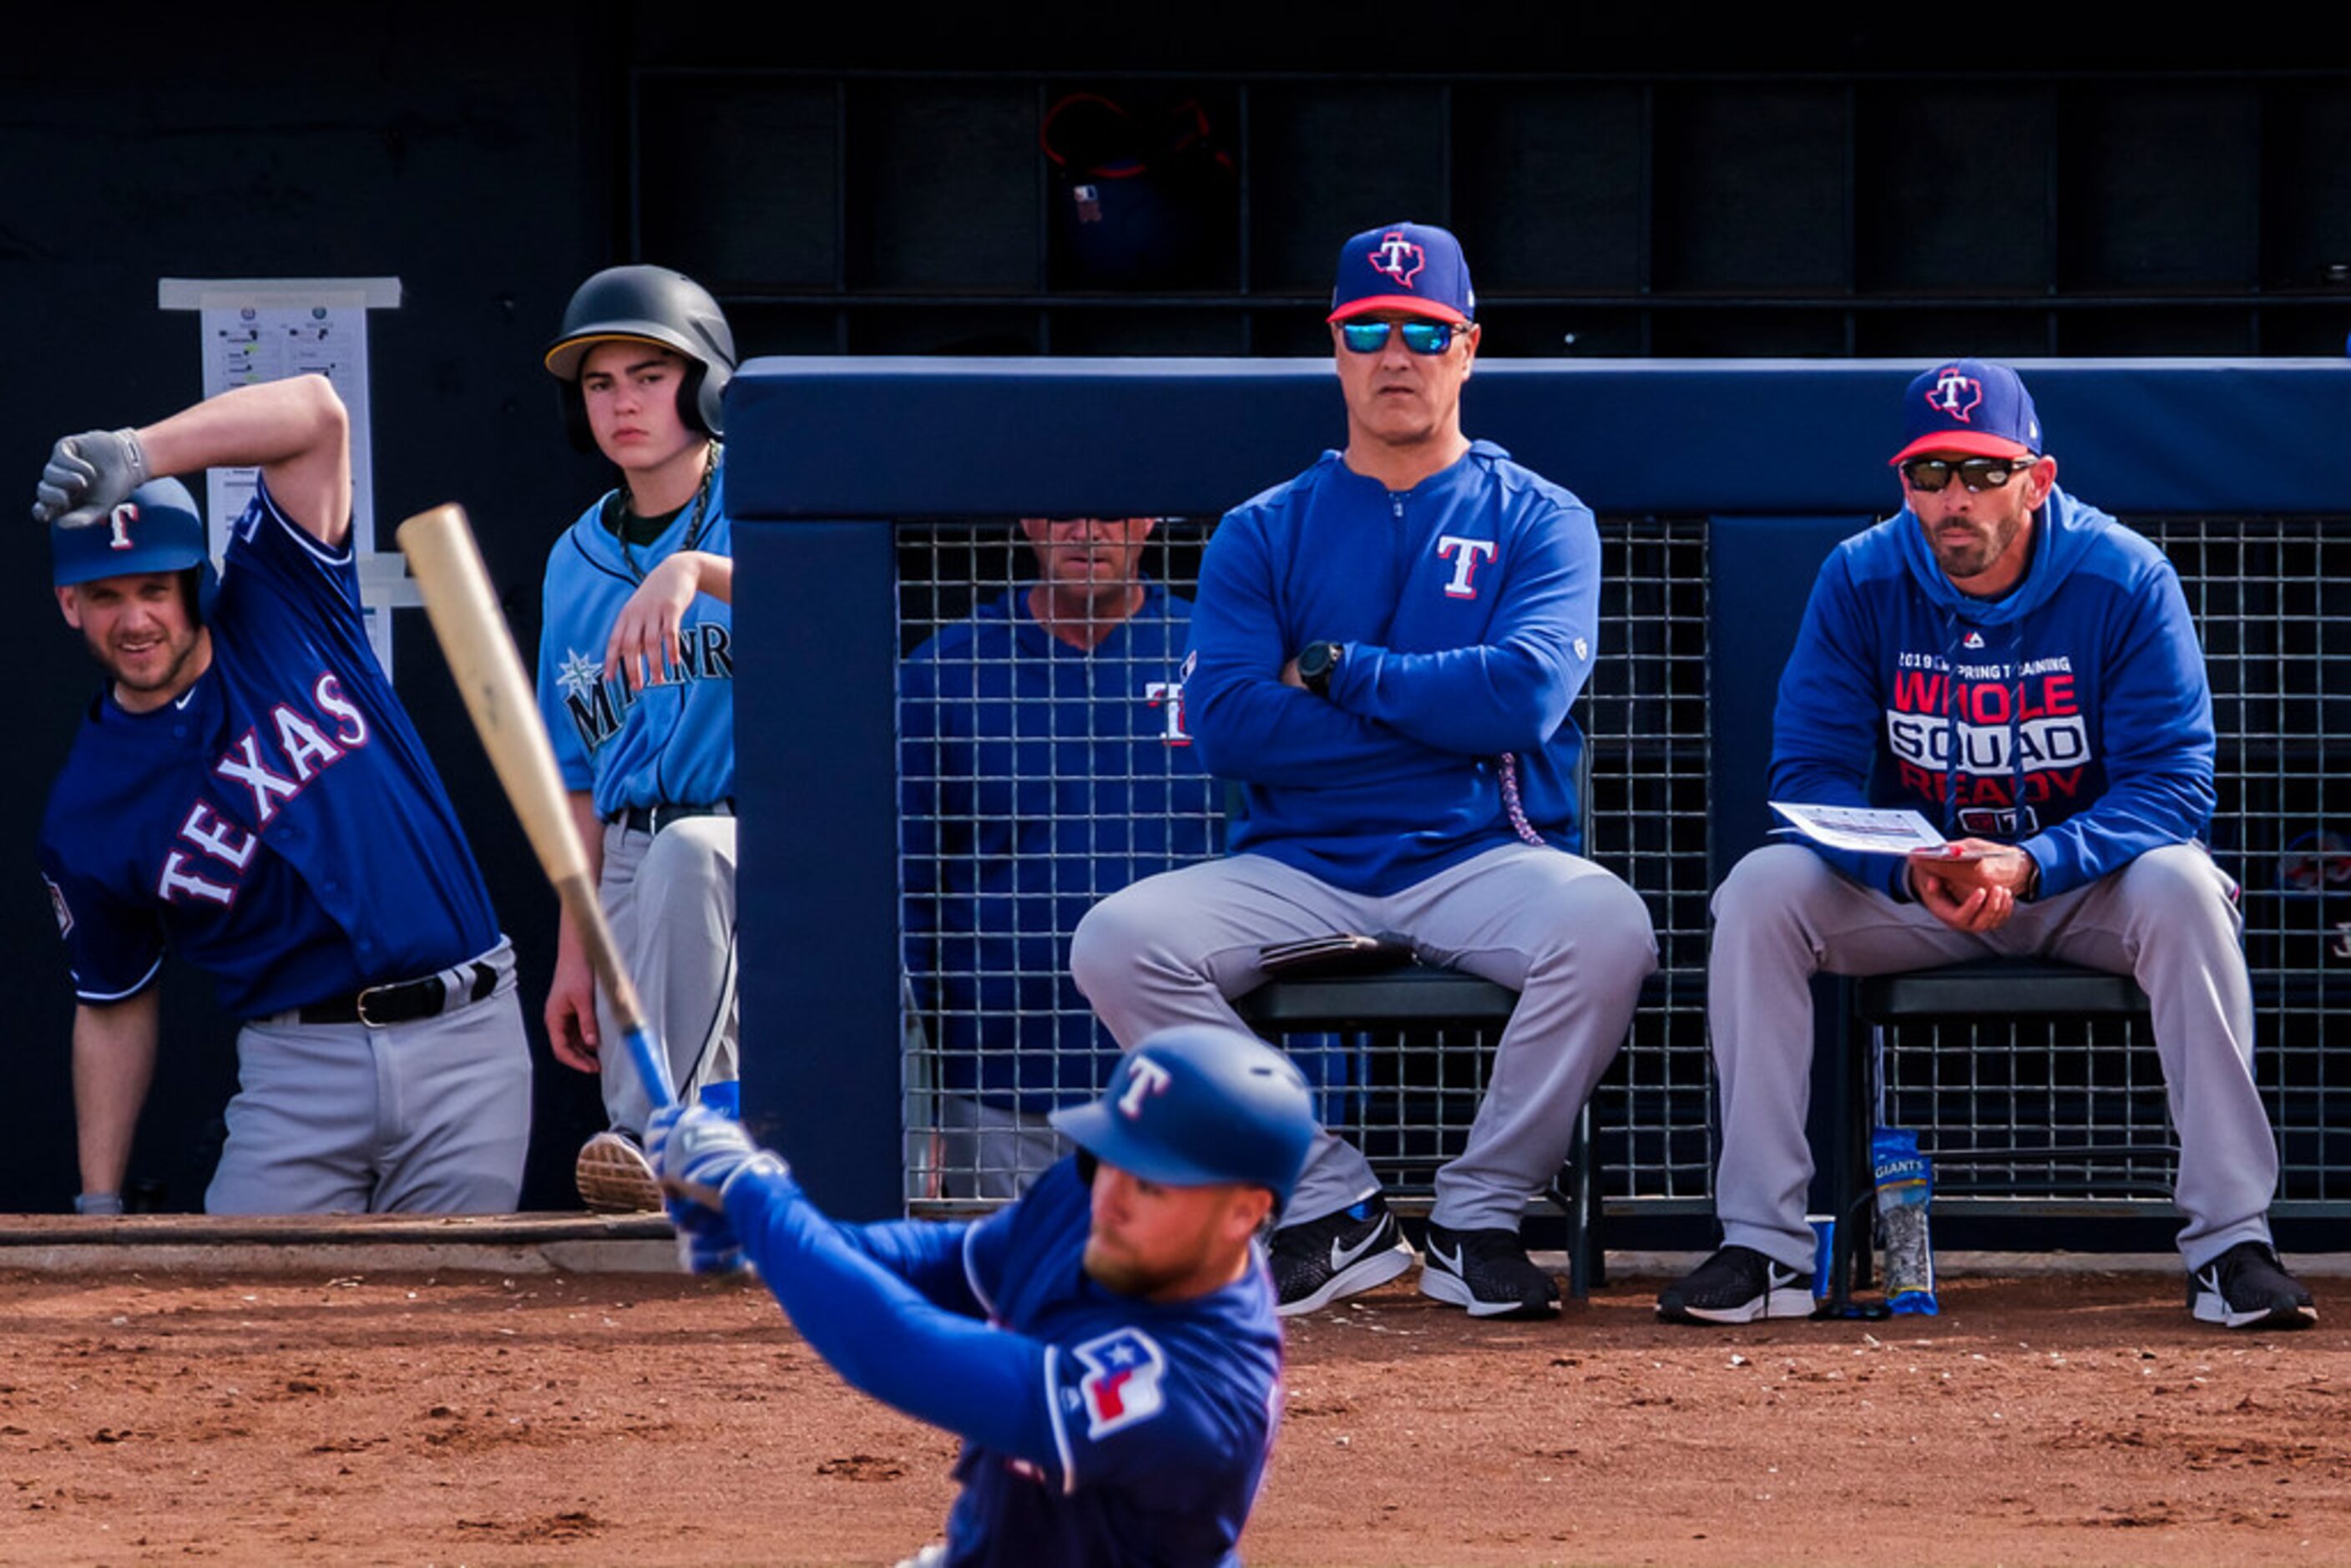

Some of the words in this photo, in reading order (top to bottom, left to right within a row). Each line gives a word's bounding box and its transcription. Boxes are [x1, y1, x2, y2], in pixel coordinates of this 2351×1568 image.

[1380, 240, 1412, 274] T
[1937, 376, 1969, 410] T
[1437, 535, 1499, 600] T
[1894, 670, 2079, 725] WHOLE
[1892, 720, 2083, 768] SQUAD
[158, 670, 370, 913] TEXAS
[1898, 760, 2084, 807] READY
[1119, 1055, 1172, 1119] T
